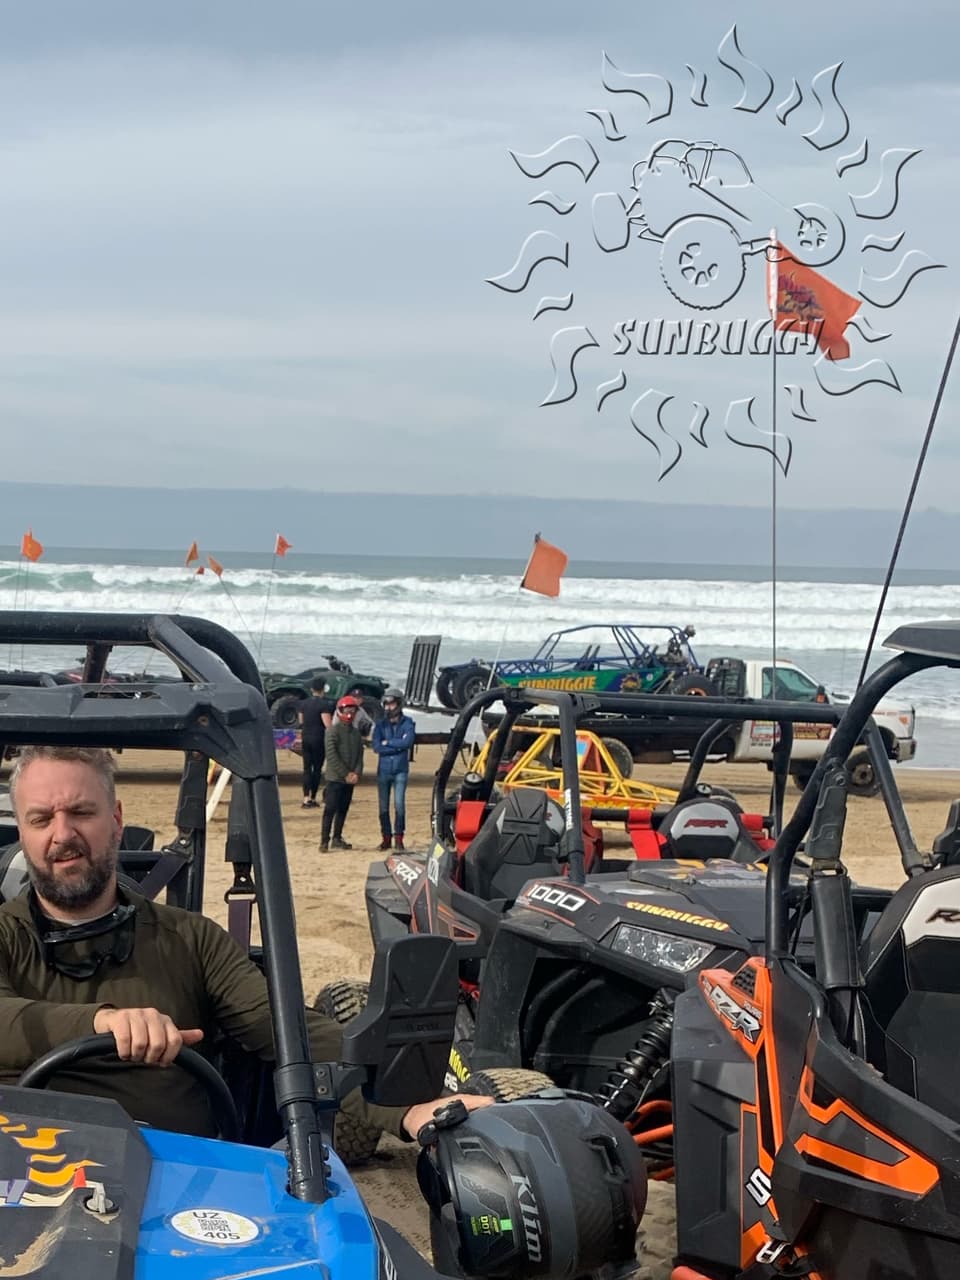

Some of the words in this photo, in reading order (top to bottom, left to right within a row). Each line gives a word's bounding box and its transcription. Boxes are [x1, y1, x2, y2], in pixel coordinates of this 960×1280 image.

[527, 883, 586, 912] 1000
[709, 983, 762, 1042] RZR
[203, 1231, 241, 1240] 405
[479, 1215, 492, 1235] DOT
